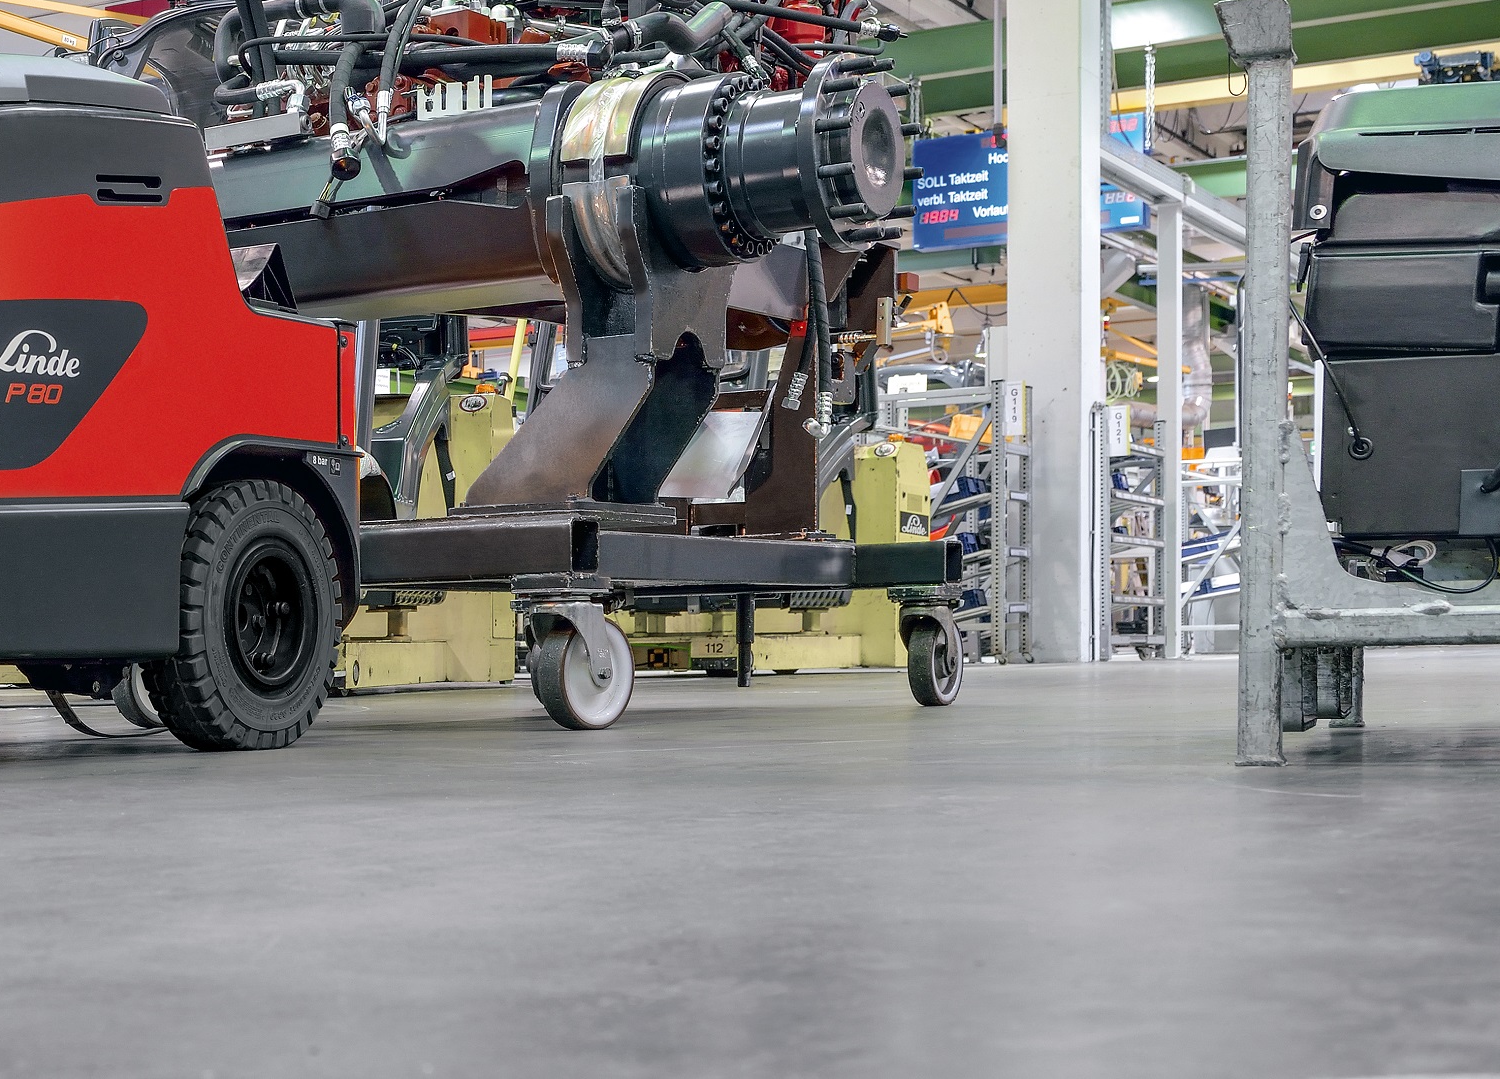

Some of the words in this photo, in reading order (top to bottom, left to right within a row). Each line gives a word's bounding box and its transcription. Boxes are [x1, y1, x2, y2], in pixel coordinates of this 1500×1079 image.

[917, 176, 947, 190] SOLL
[948, 170, 989, 185] Taktzeit
[917, 193, 946, 206] verbl.
[948, 188, 988, 203] Taktzeit
[4, 383, 27, 404] P
[27, 383, 63, 404] 80
[312, 455, 317, 465] 8
[317, 455, 328, 466] bar
[901, 514, 928, 536] Linde
[216, 510, 280, 574] CONTINENTAL
[705, 643, 724, 654] 112
